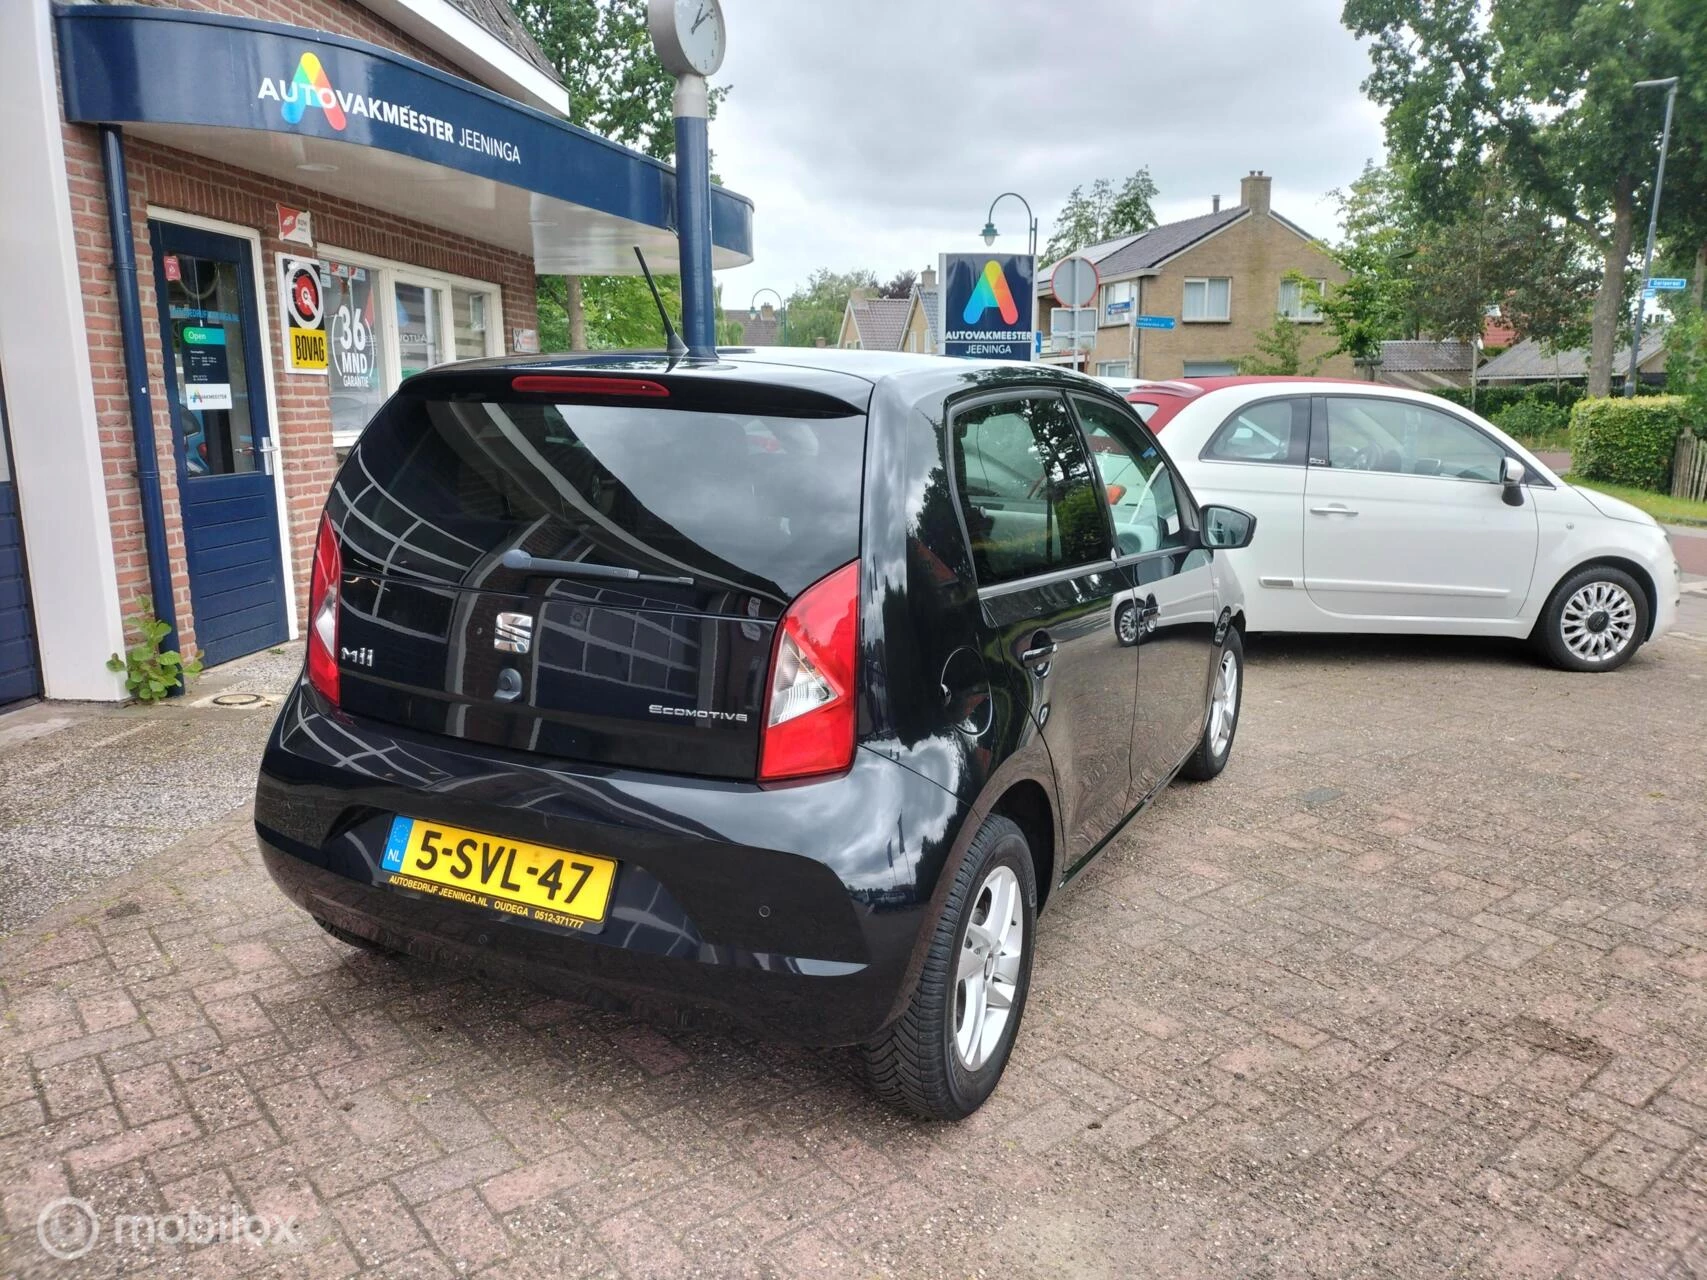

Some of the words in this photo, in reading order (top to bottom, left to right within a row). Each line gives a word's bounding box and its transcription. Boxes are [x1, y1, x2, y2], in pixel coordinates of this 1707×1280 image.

[257, 77, 455, 144] AUTOVAKMEESTER
[459, 127, 521, 164] JEENINGA
[187, 330, 207, 341] Open
[338, 304, 366, 351] 36
[945, 330, 1033, 341] AUTOVAKMEESTER
[294, 334, 325, 362] BOVAG
[965, 344, 1012, 355] JEENINGA
[341, 351, 368, 374] MND
[342, 375, 370, 387] GARANTIE
[341, 647, 373, 667] Mii
[387, 848, 401, 863] NL
[415, 829, 595, 904] 5-SVL-47
[388, 875, 438, 895] AUTOBEDRIJF
[438, 886, 489, 907] JEENINGA.NL
[494, 900, 529, 917] OUDEGA
[534, 910, 584, 929] 0512-371777
